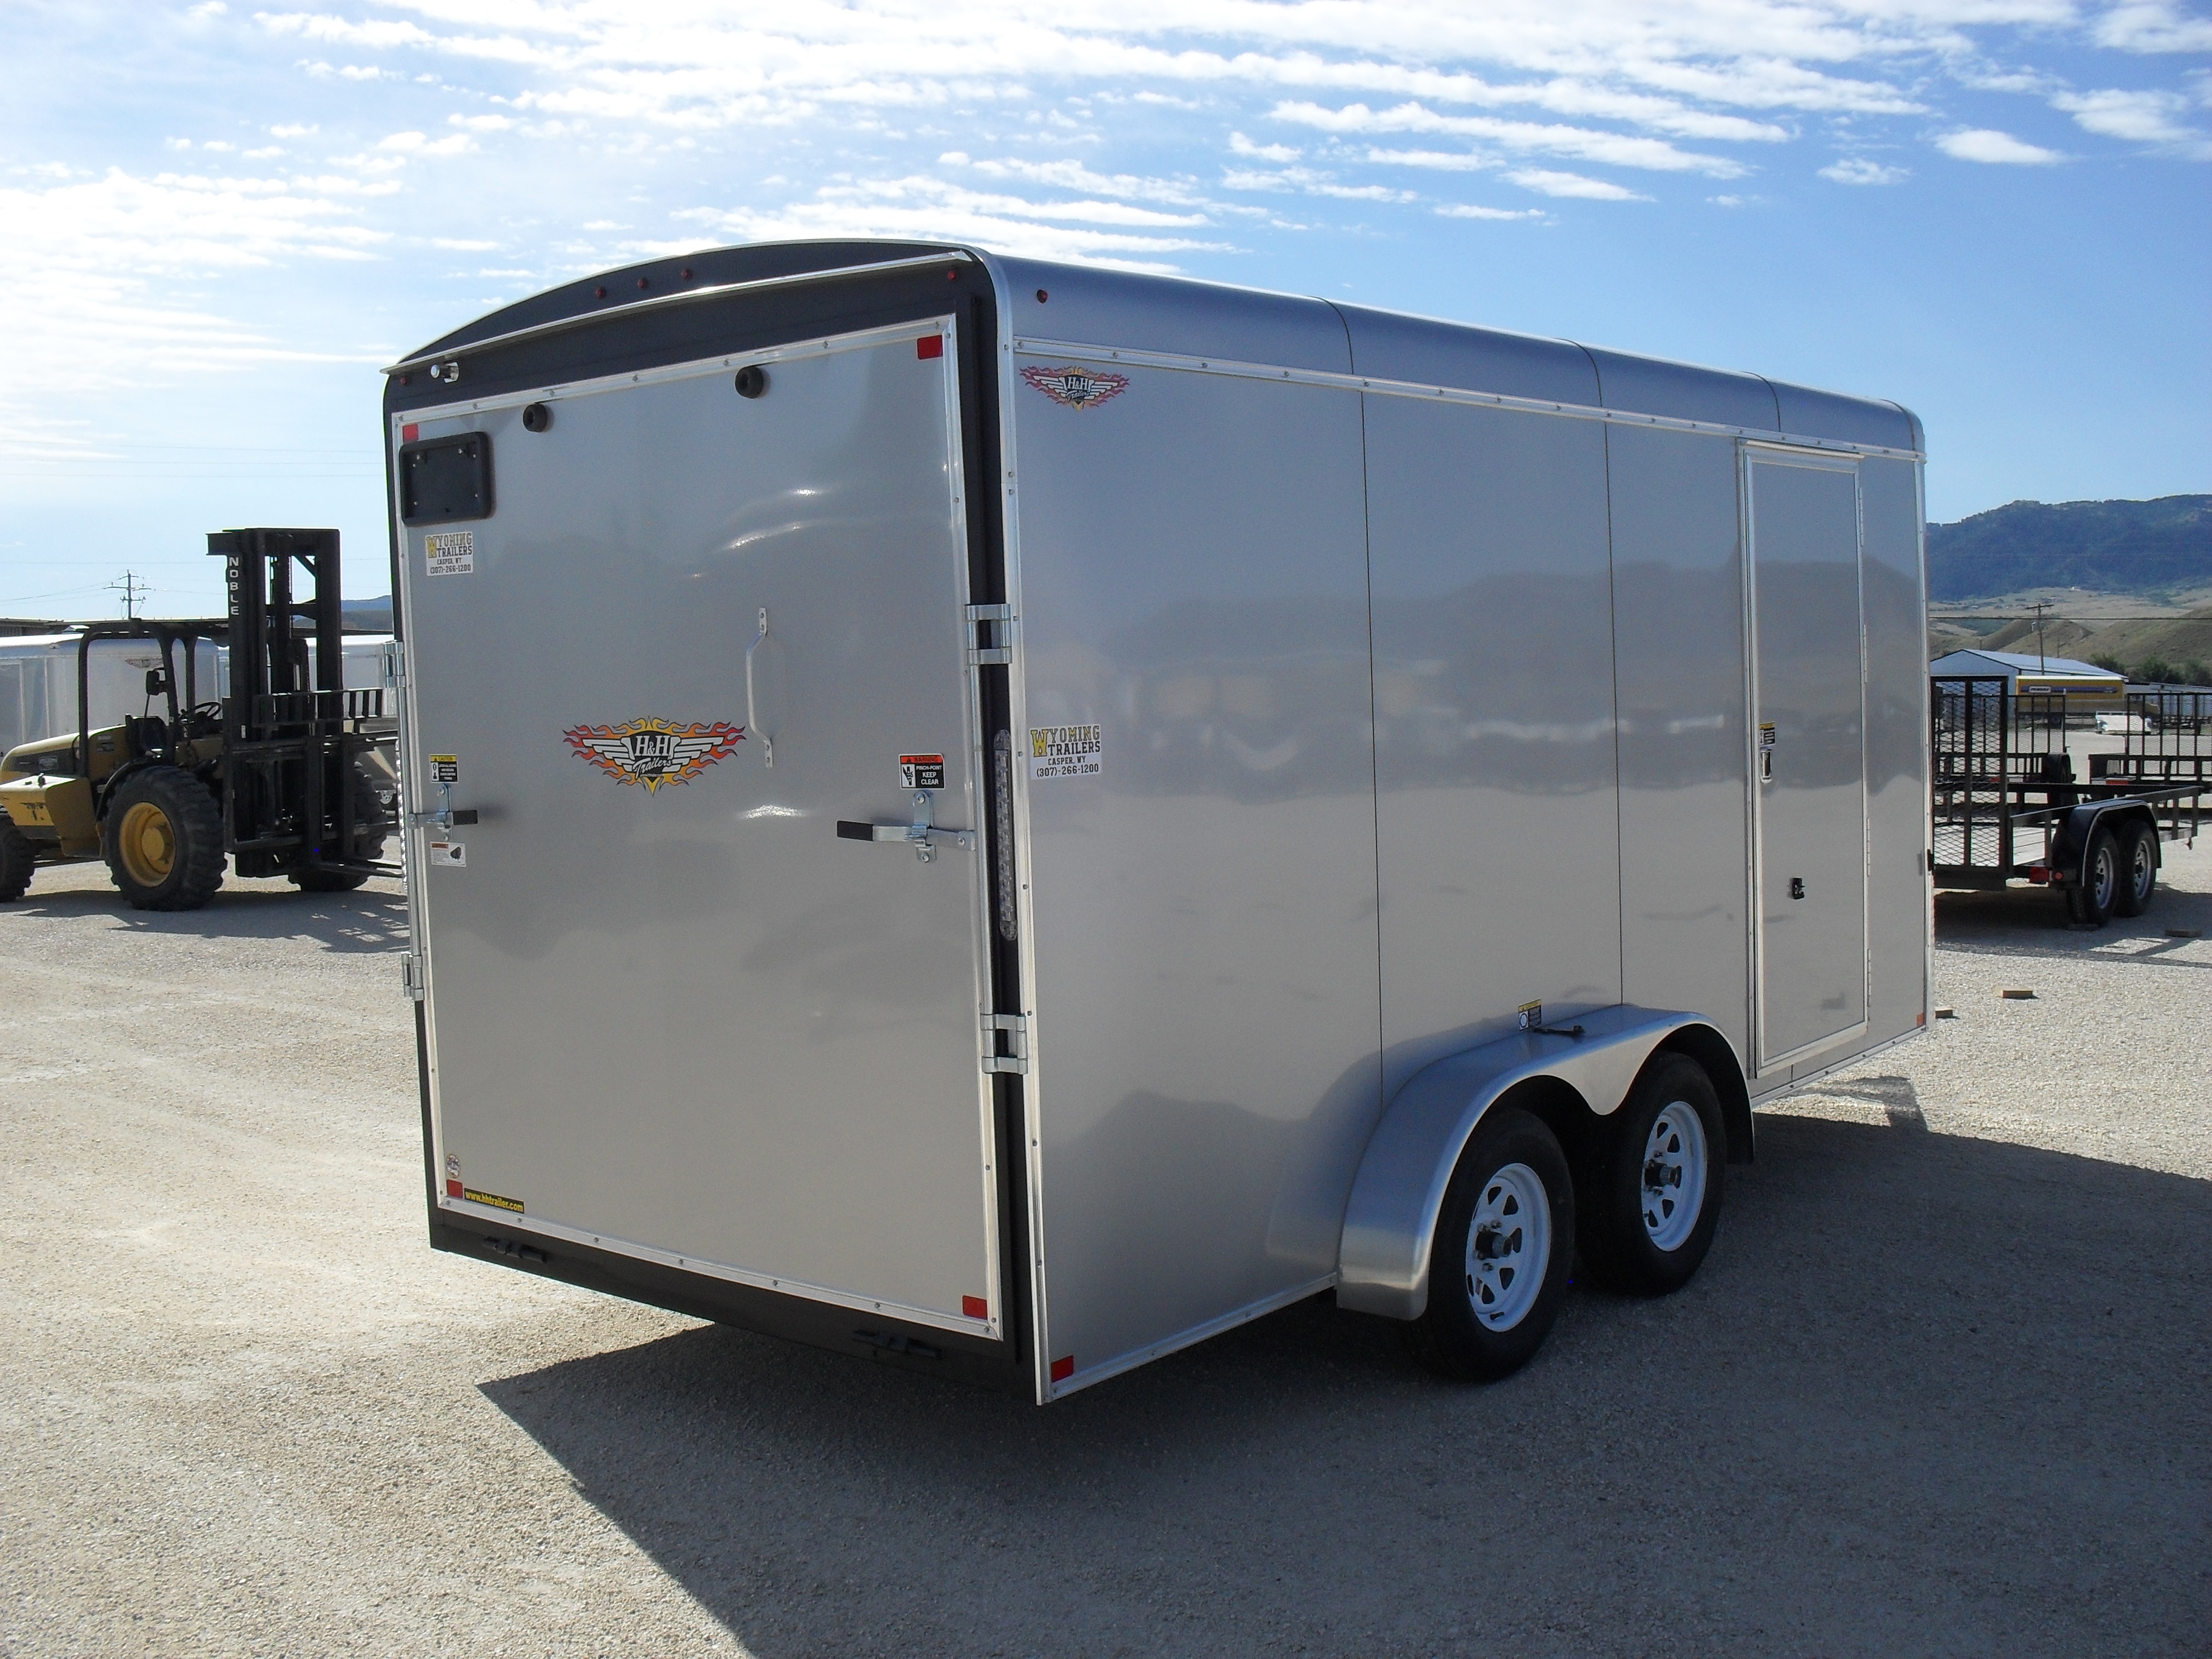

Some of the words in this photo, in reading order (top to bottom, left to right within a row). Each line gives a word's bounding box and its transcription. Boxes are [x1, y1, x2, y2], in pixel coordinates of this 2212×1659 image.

[1067, 377, 1088, 390] H&H
[426, 532, 472, 558] WYOMING
[437, 546, 472, 557] TRAILERS
[229, 557, 240, 615] NOBLE
[634, 735, 671, 756] H&H
[1031, 726, 1100, 757] WYOMING
[1048, 741, 1101, 756] TRAILERS
[632, 757, 671, 779] Trailers
[1036, 763, 1099, 777] (307)-266-1200
[1048, 757, 1075, 765] CASPER,
